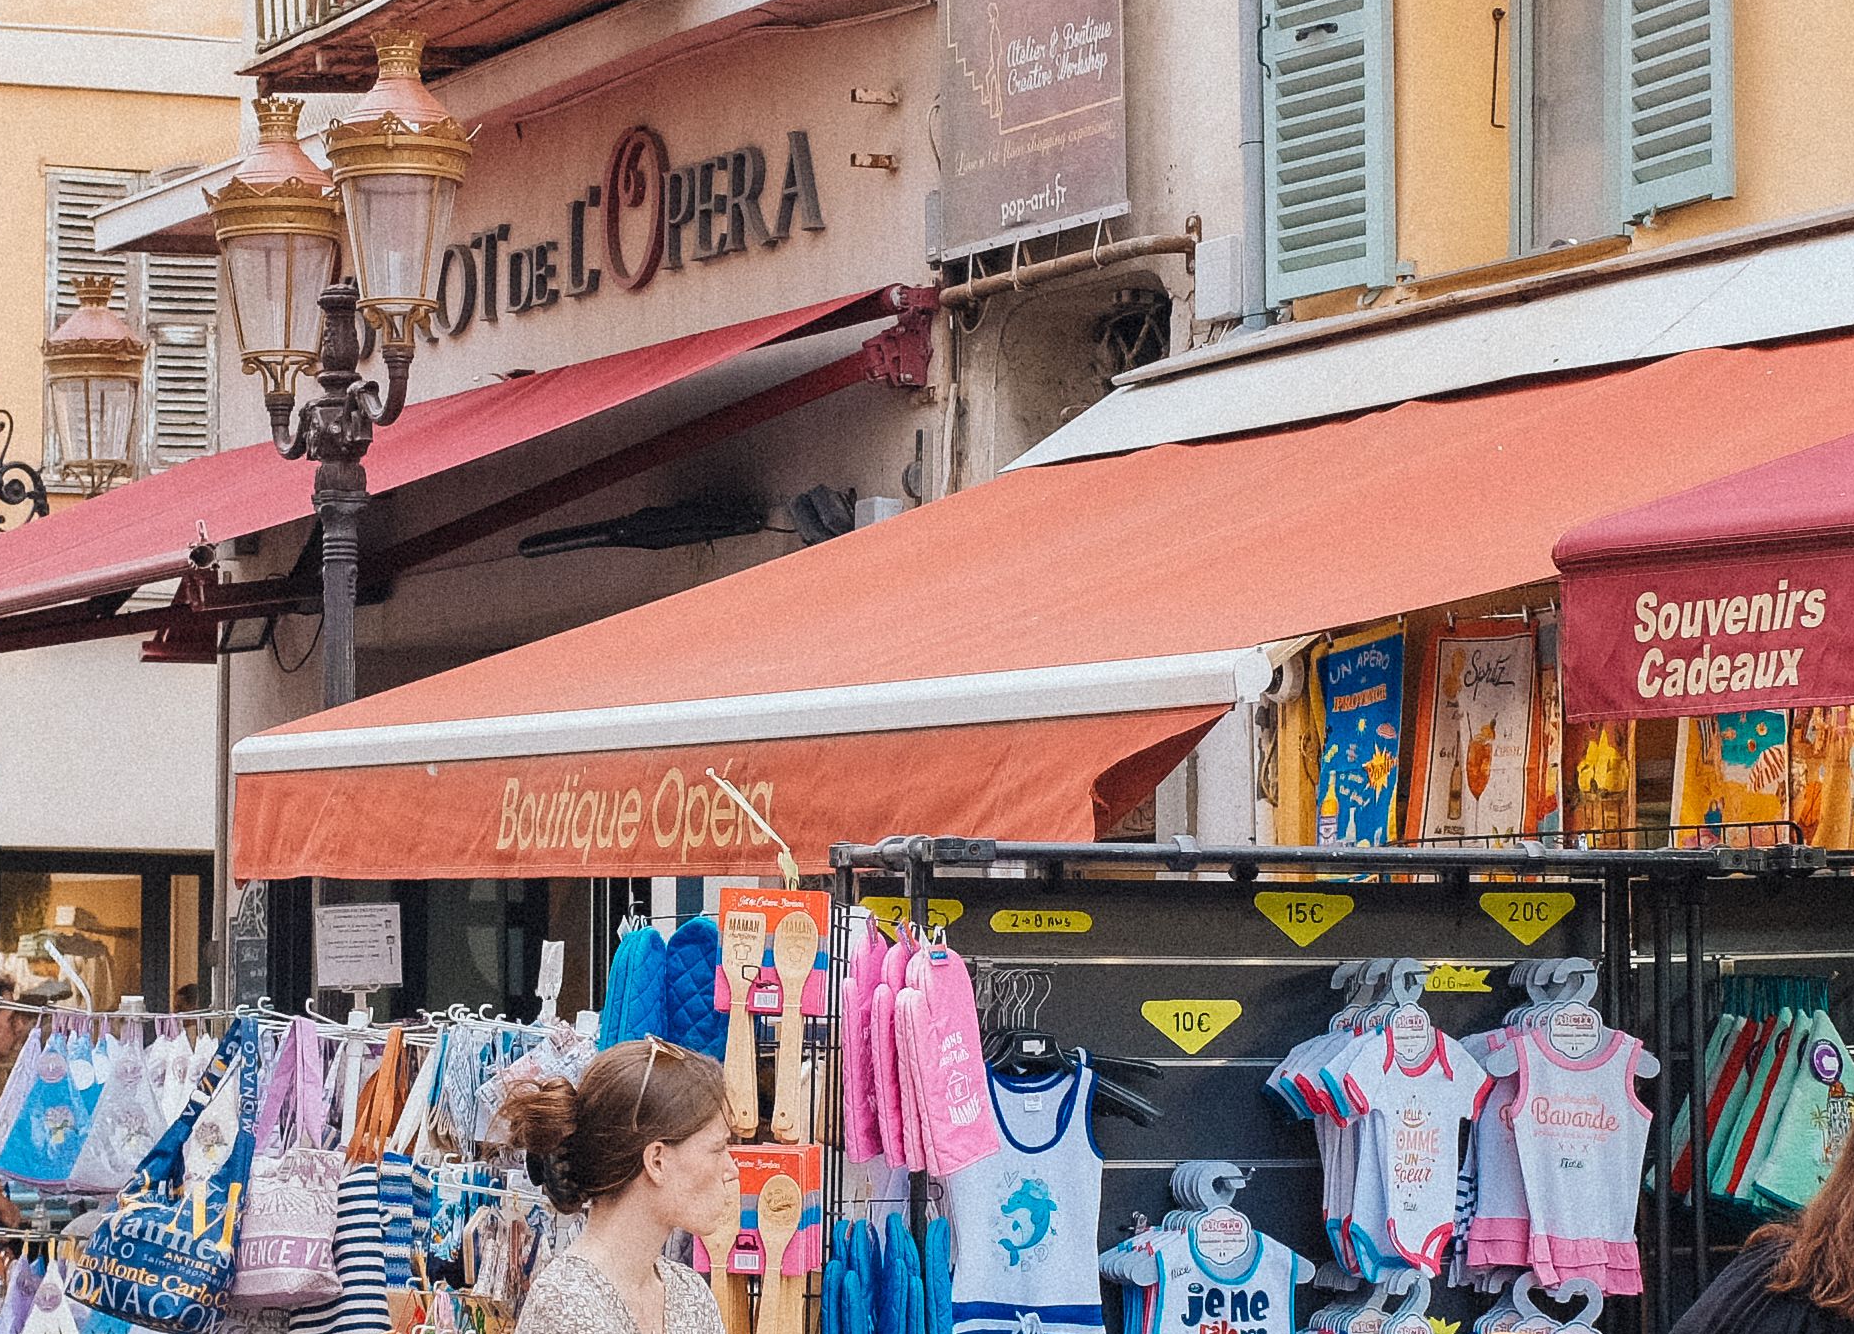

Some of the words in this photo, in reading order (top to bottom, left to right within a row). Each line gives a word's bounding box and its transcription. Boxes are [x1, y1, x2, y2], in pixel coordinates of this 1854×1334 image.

[1006, 35, 1047, 68] Atelier
[1062, 15, 1113, 51] Boutique
[1006, 67, 1054, 96] Creative
[1054, 51, 1109, 82] Workshop
[1001, 173, 1068, 227] pop-art.fr
[506, 239, 561, 314] DE
[1633, 579, 1827, 643] Souvenirs
[1463, 649, 1515, 701] Spritz
[1637, 643, 1805, 699] Cadeaux
[496, 766, 643, 866] Boutique
[652, 757, 774, 864] Opéra
[728, 918, 760, 934] MAMAN
[1285, 902, 1325, 924] 15€
[1507, 900, 1549, 923] 20€
[1172, 1011, 1211, 1033] 10€
[240, 1039, 258, 1135] MONACO
[1531, 1096, 1620, 1132] Bavarde
[1404, 1153, 1419, 1166] UN
[109, 1212, 231, 1269] Cannes
[163, 1250, 218, 1277] ANTIBES
[101, 1255, 159, 1287] Monte
[161, 1274, 213, 1307] Carlo
[1180, 1282, 1225, 1327] je
[1230, 1288, 1270, 1323] ne
